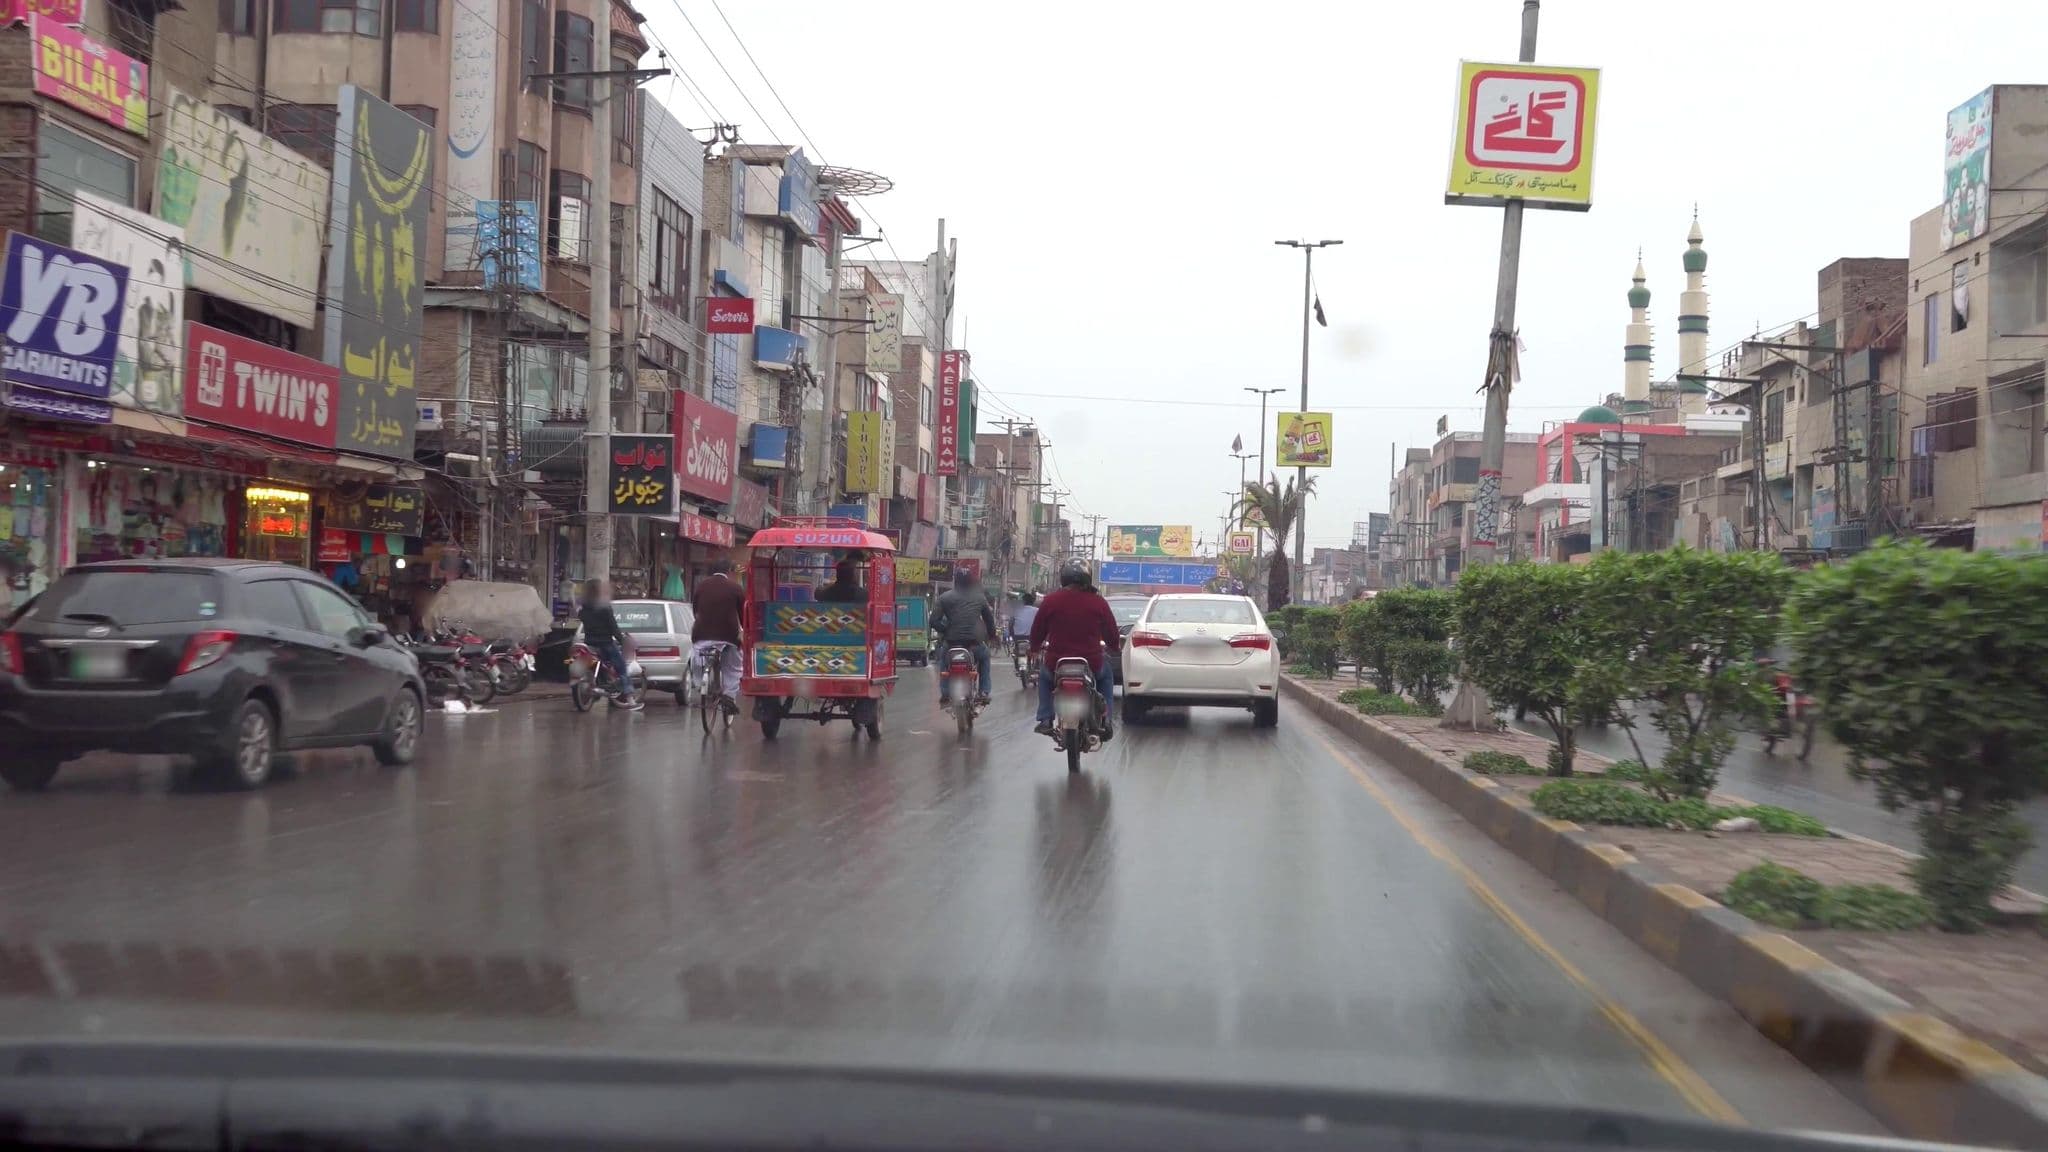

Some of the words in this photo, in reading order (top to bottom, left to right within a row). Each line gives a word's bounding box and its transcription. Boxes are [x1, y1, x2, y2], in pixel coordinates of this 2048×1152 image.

[41, 35, 122, 107] BILAL
[7, 243, 119, 356] YB
[711, 308, 749, 323] Servis
[344, 336, 415, 398] نواب
[943, 354, 956, 406] SAEED
[233, 360, 330, 428] TWIN'S
[351, 399, 404, 447] جیولرز
[939, 415, 955, 468] IKRAM
[614, 440, 667, 472] نواب
[366, 490, 415, 513] نواب
[370, 515, 405, 529] جیولرز
[793, 533, 862, 544] SUZUKI
[1233, 536, 1250, 548] GAI
